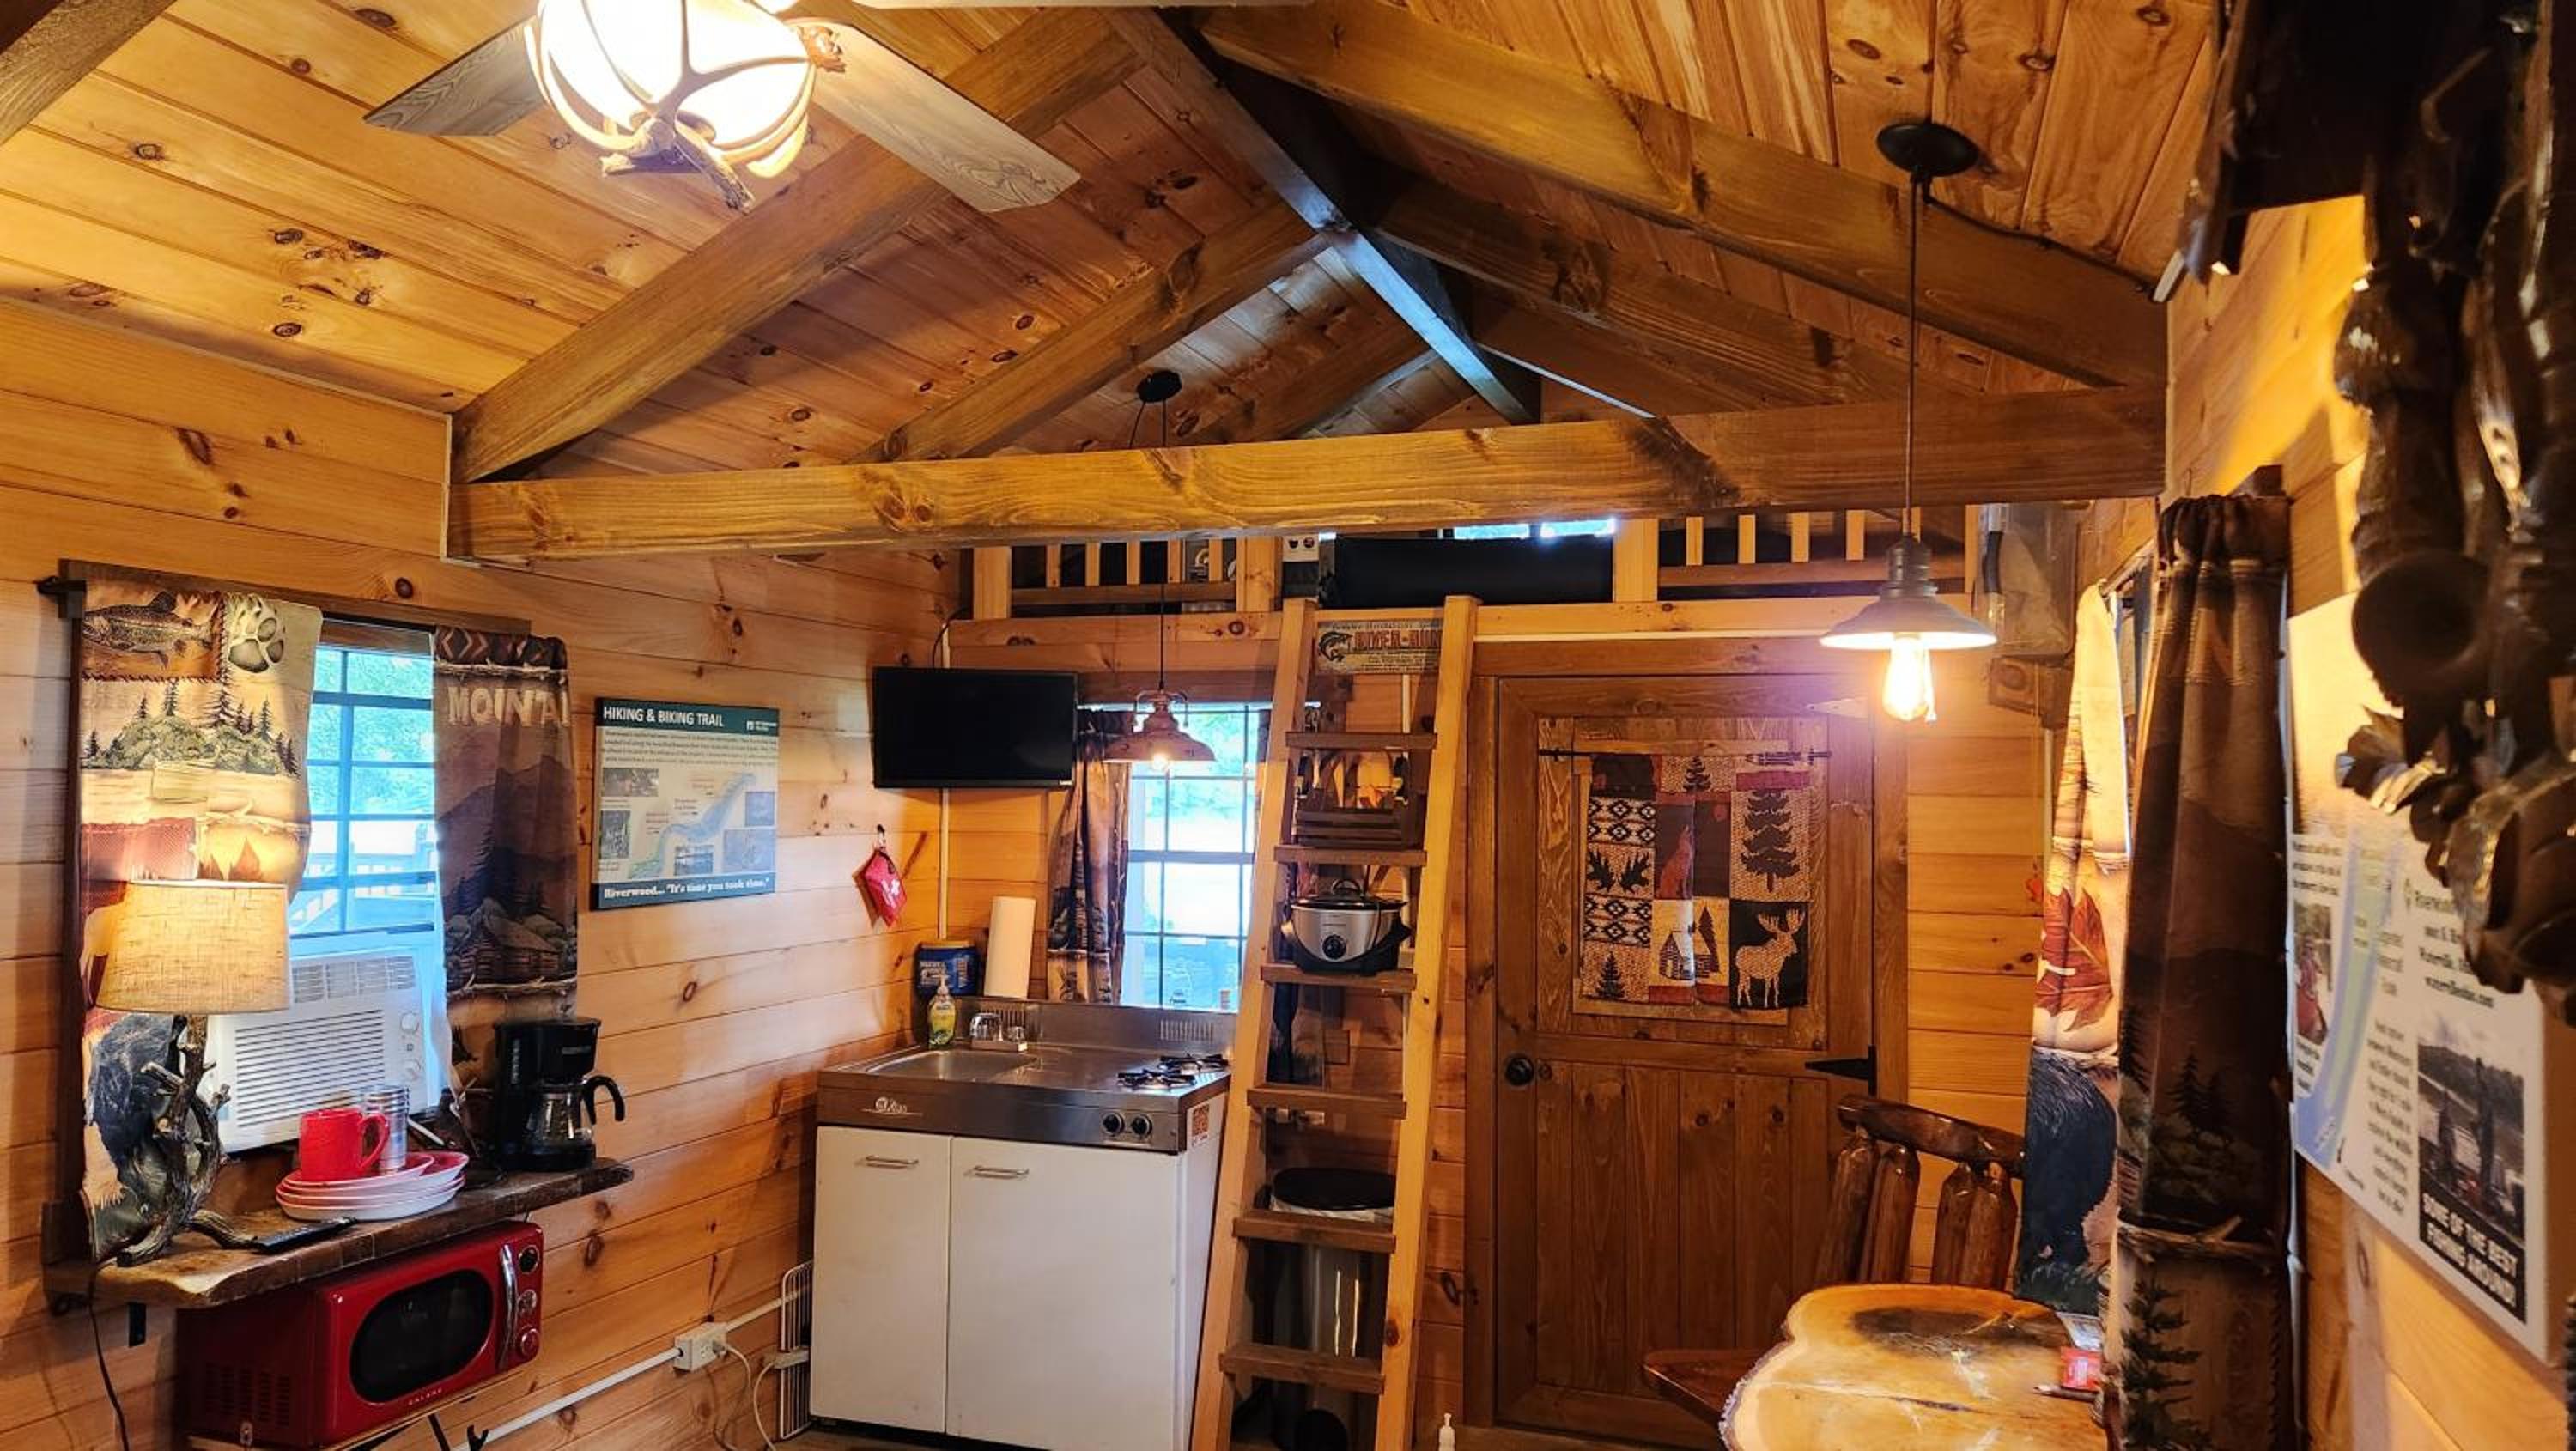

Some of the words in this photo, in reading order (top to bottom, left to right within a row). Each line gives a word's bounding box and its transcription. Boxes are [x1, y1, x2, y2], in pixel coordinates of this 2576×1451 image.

[603, 706, 643, 722] HIKING
[647, 710, 655, 722] &
[658, 710, 695, 725] BIKING
[696, 713, 724, 727] TRAIL
[686, 882, 707, 891] time
[708, 883, 724, 894] you
[725, 880, 744, 890] took
[2422, 1193, 2449, 1228] SOME
[2450, 1211, 2464, 1237] OF
[2465, 1223, 2487, 1255] THE
[2488, 1240, 2518, 1278] BEST
[2427, 1223, 2466, 1267] FISHING
